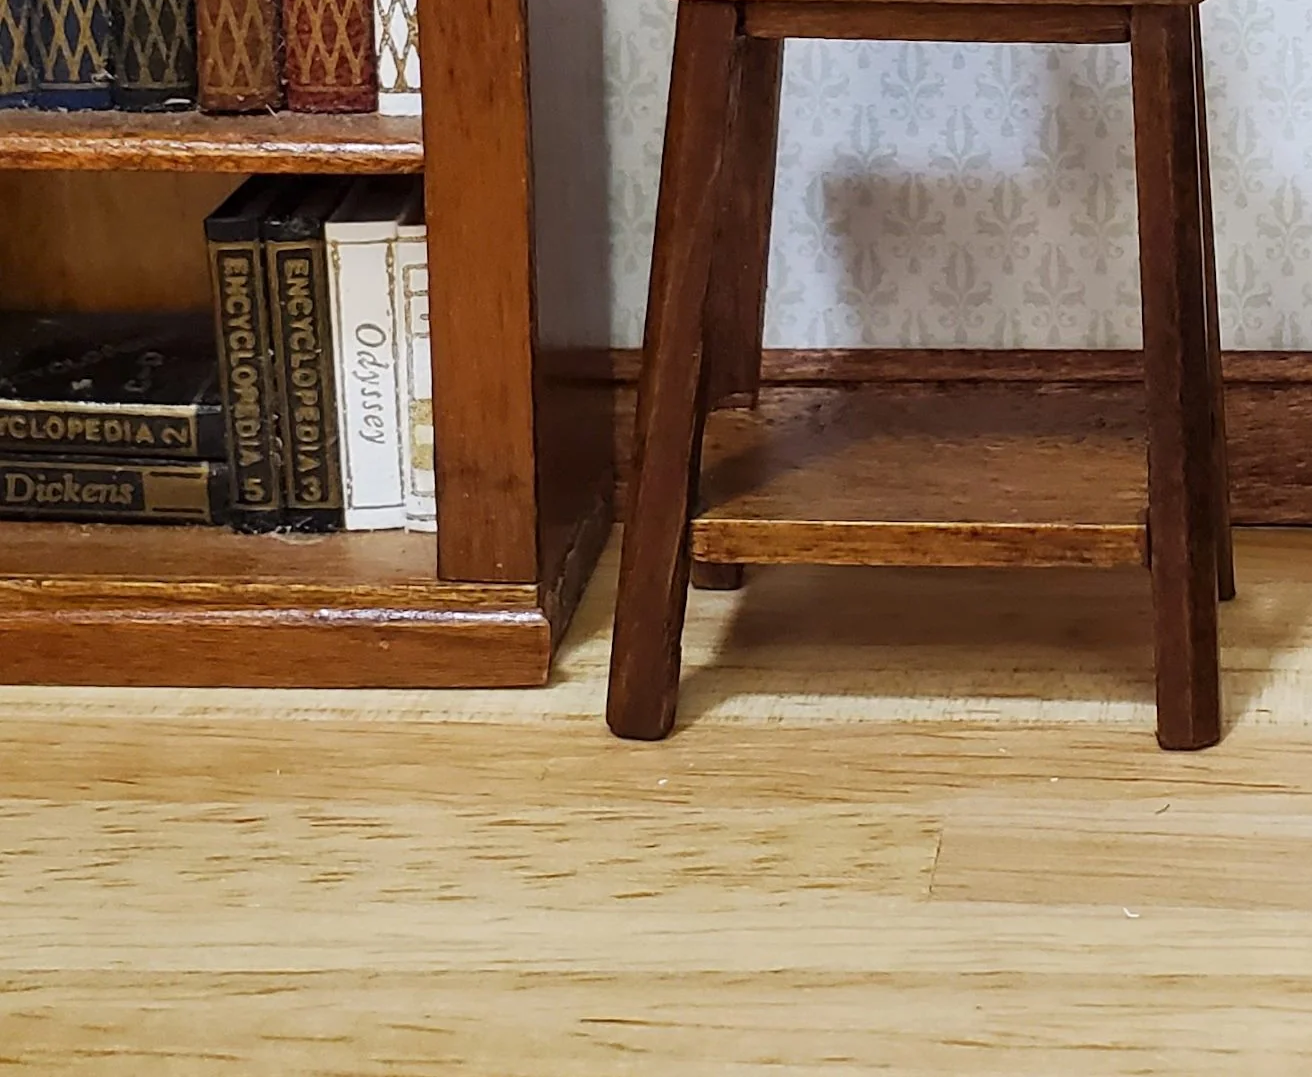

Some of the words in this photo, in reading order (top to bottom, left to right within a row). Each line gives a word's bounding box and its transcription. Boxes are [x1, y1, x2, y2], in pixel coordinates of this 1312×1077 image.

[222, 257, 264, 468] ENCYCLOPEDIA
[283, 257, 322, 471] ENCYCLOPEDIA
[352, 322, 389, 445] Odyssey
[161, 426, 189, 445] 2
[5, 471, 136, 507] Dickens
[242, 478, 266, 502] 5
[301, 477, 323, 503] 3
